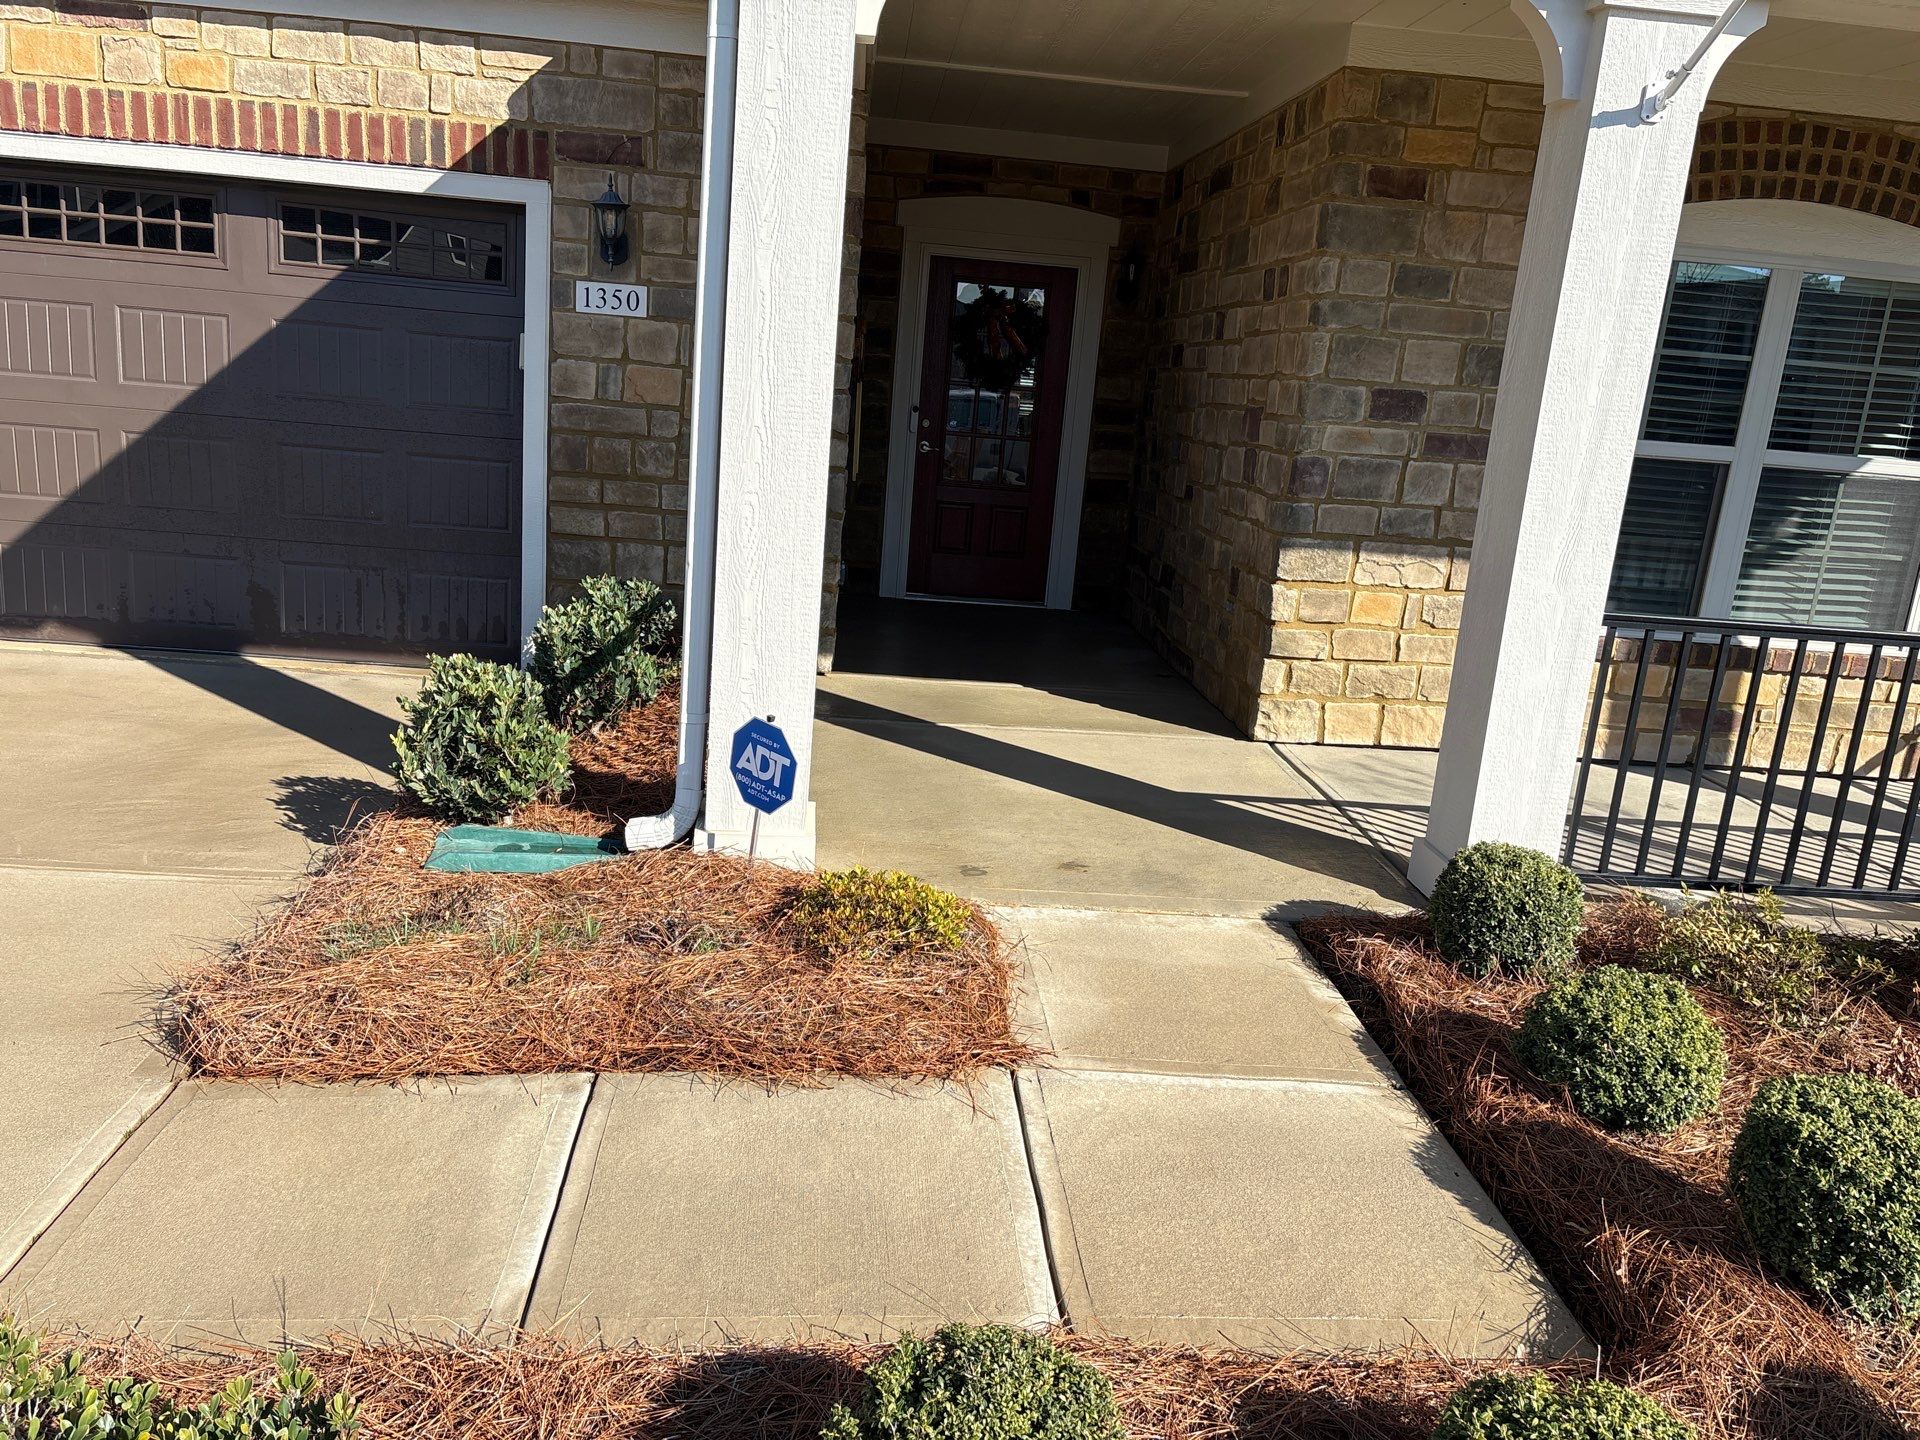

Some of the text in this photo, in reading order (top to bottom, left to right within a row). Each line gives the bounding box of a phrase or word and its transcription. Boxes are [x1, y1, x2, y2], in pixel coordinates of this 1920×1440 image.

[584, 287, 640, 312] 1350
[751, 732, 773, 746] SECURED
[736, 741, 791, 788] ADT
[736, 772, 786, 802] (800) ADT-ASAP
[747, 788, 770, 803] ADT.COM
